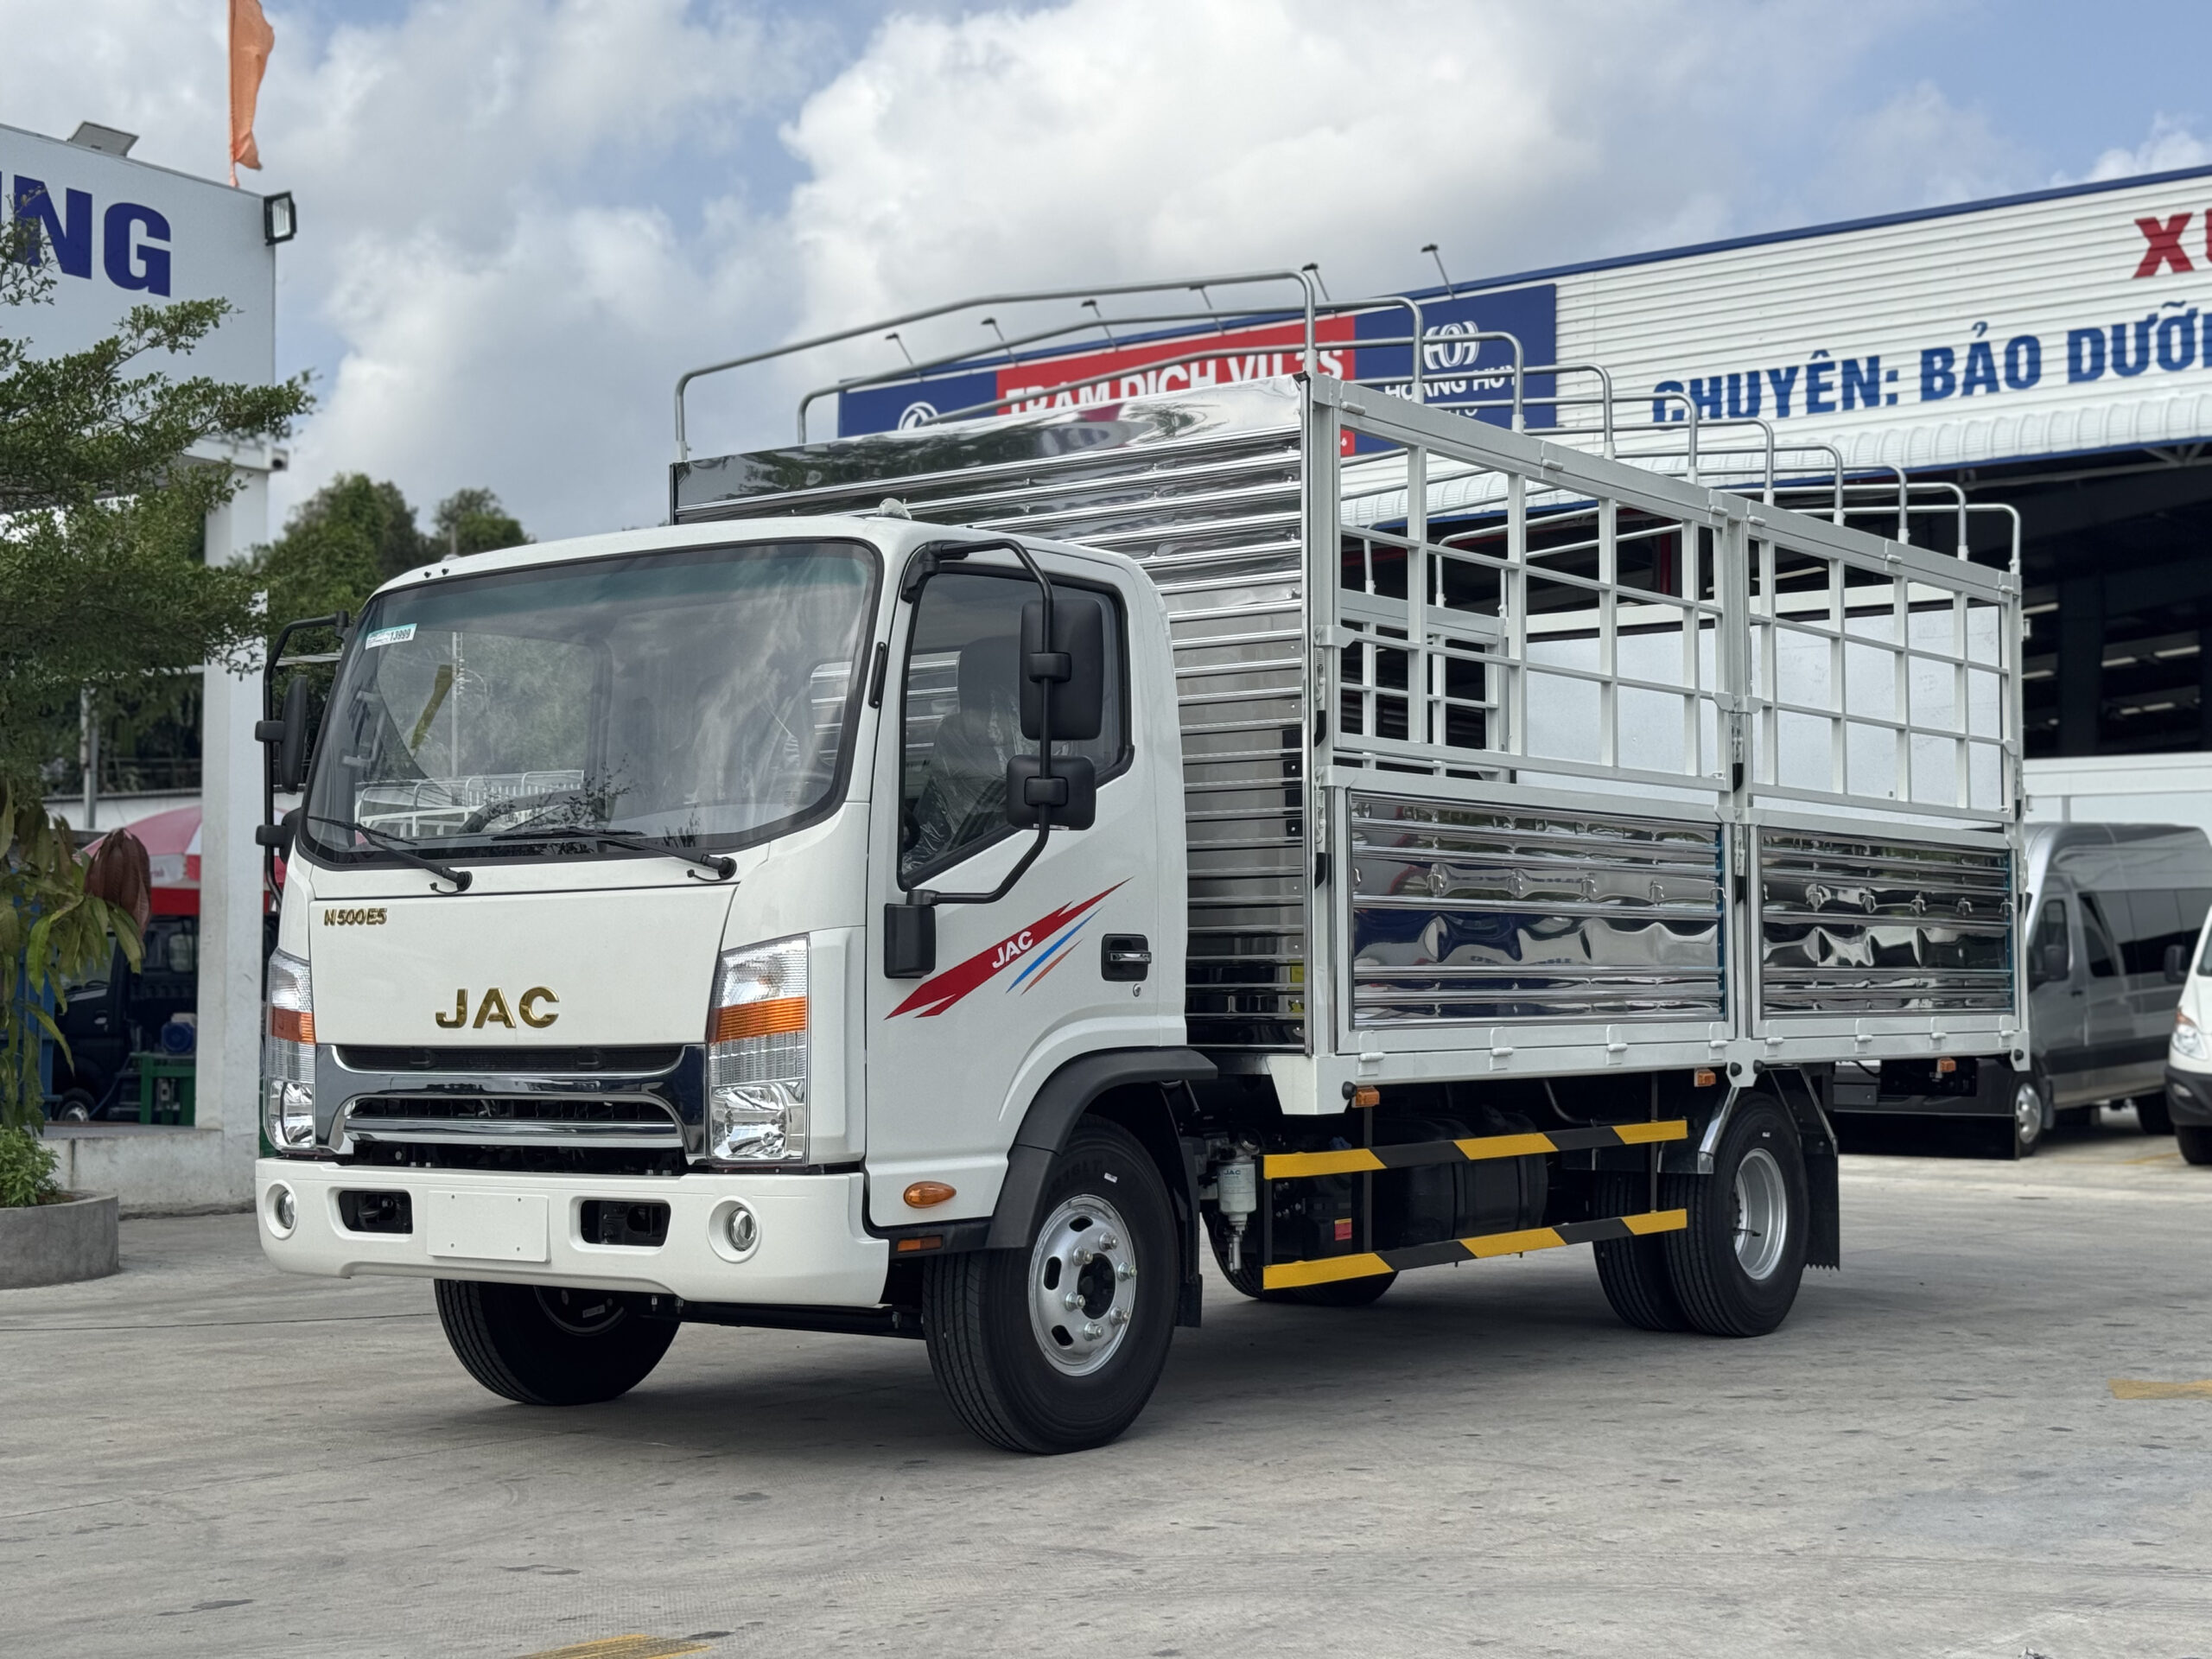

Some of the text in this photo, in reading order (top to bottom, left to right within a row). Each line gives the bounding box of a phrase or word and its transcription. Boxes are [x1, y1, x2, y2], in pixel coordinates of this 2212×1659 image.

[0, 170, 171, 298] NG
[2132, 207, 2212, 279] X
[1384, 380, 1467, 402] HONG
[1652, 300, 2212, 431] CHUYÊN: BẢO DƯỠ
[991, 931, 1033, 969] JAC
[435, 986, 560, 1029] JAC
